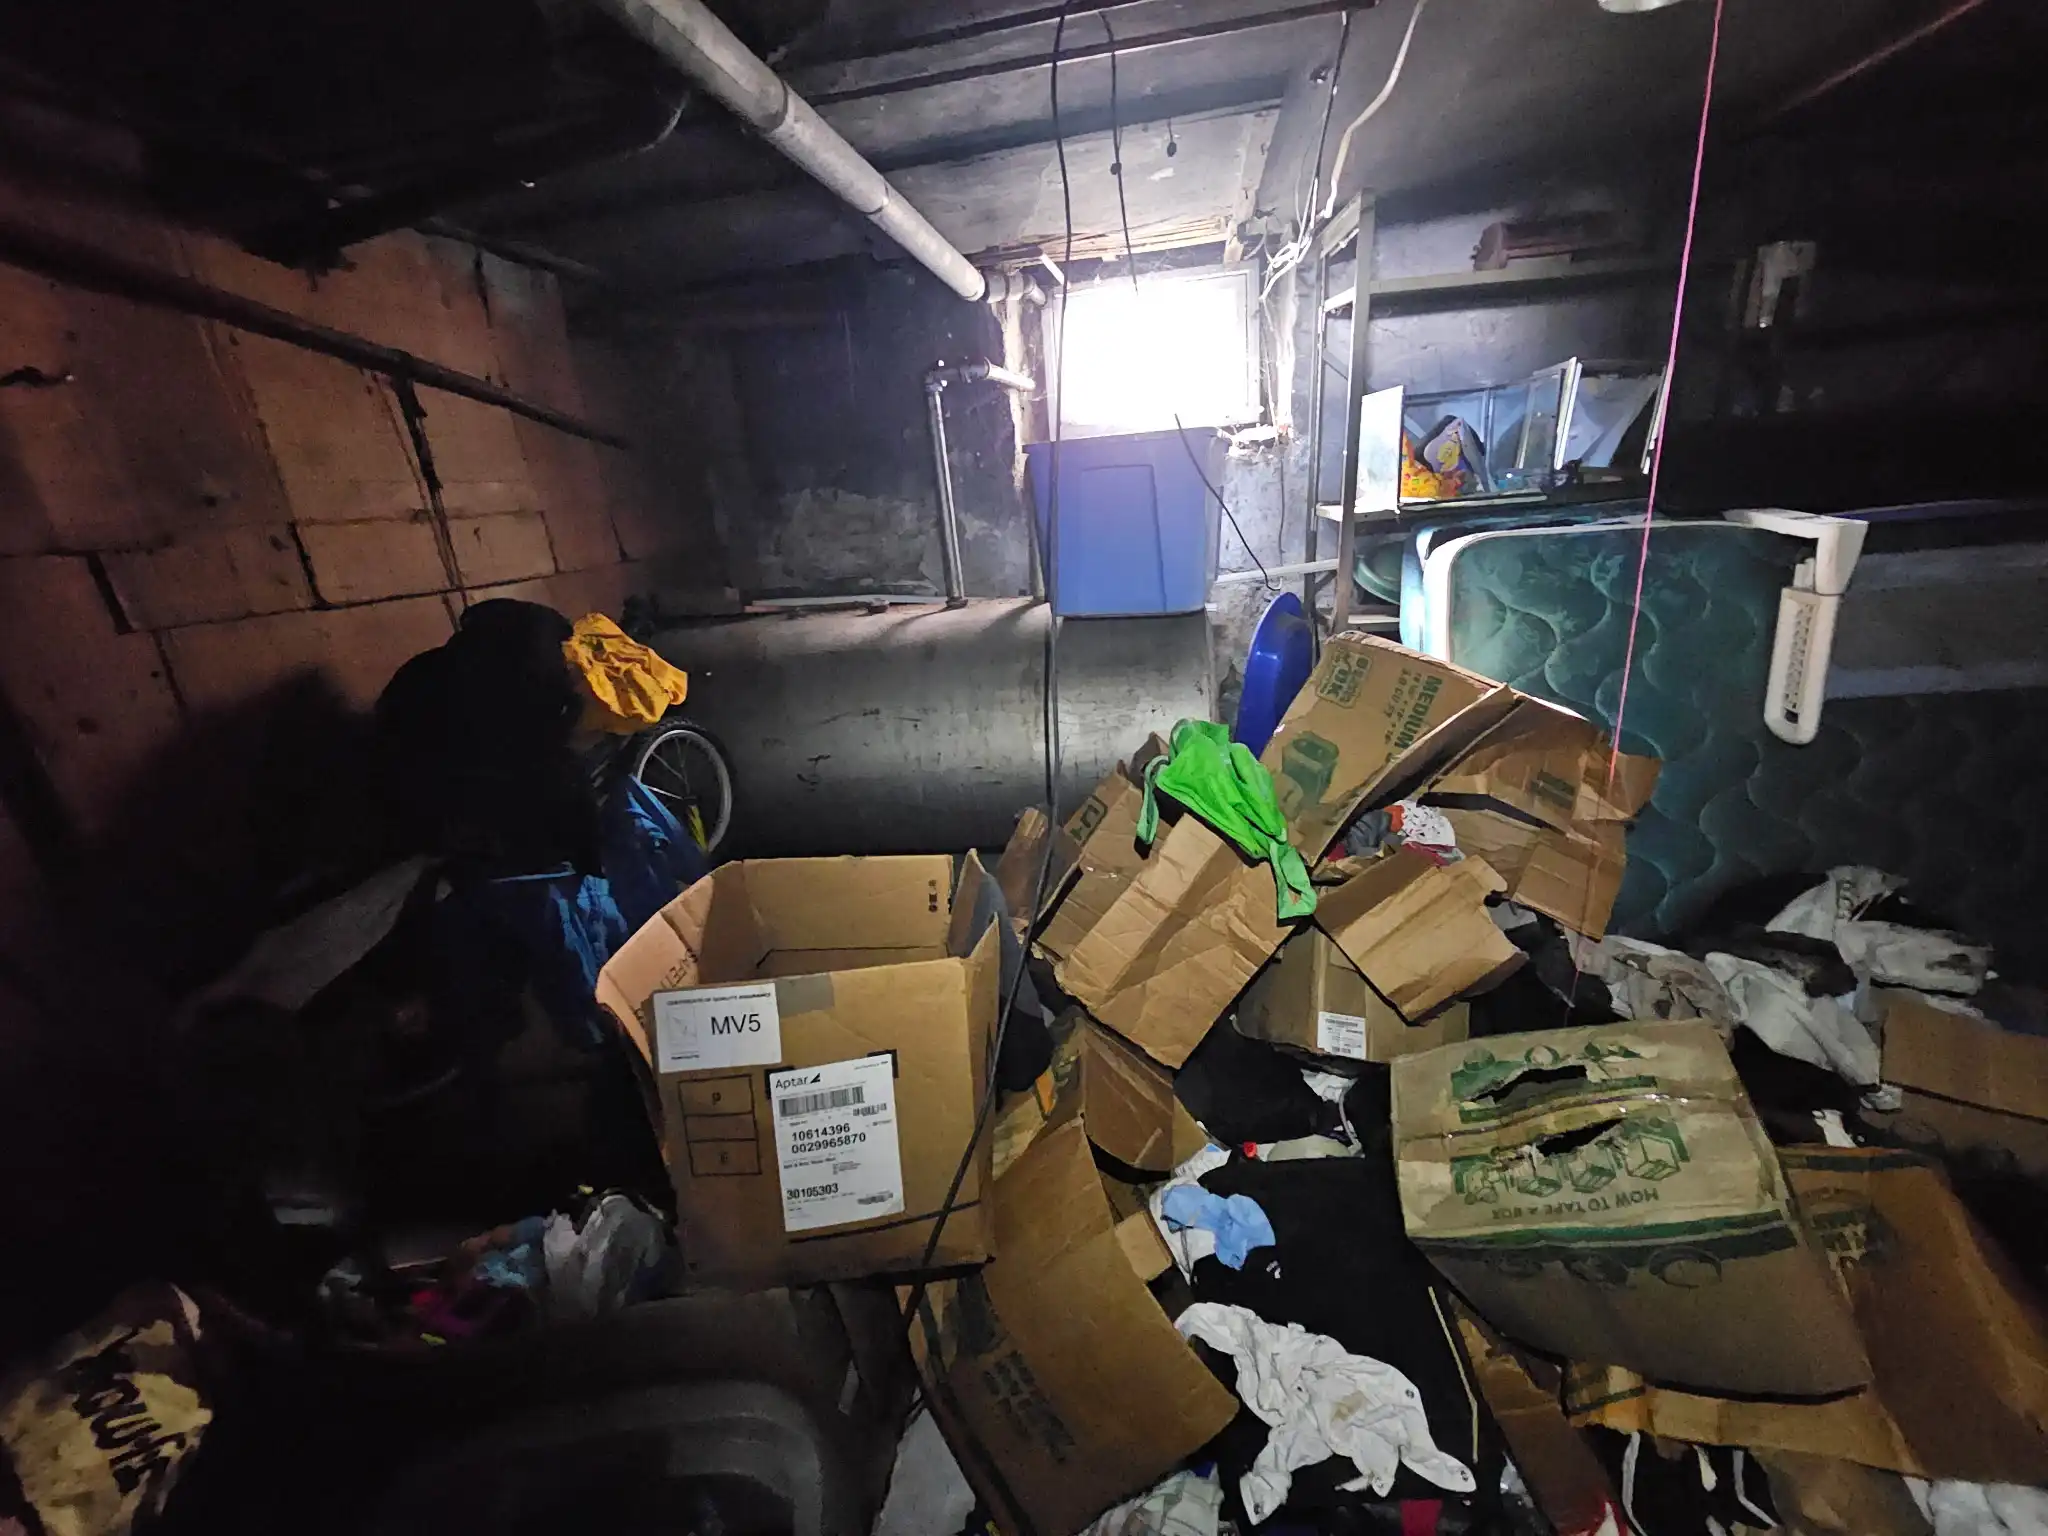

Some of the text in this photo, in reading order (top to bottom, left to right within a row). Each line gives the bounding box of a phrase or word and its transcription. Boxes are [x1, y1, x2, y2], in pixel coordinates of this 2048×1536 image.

[1394, 675, 1442, 749] MEDIUM
[710, 1013, 761, 1036] MV5
[775, 1076, 809, 1090] Aptar
[791, 1122, 851, 1142] 10614396
[791, 1132, 867, 1155] 0029965870
[786, 1182, 839, 1201] 30105303
[1615, 1187, 1659, 1209] HOW
[1544, 1201, 1586, 1214] TAPE
[1588, 1196, 1611, 1212] TO
